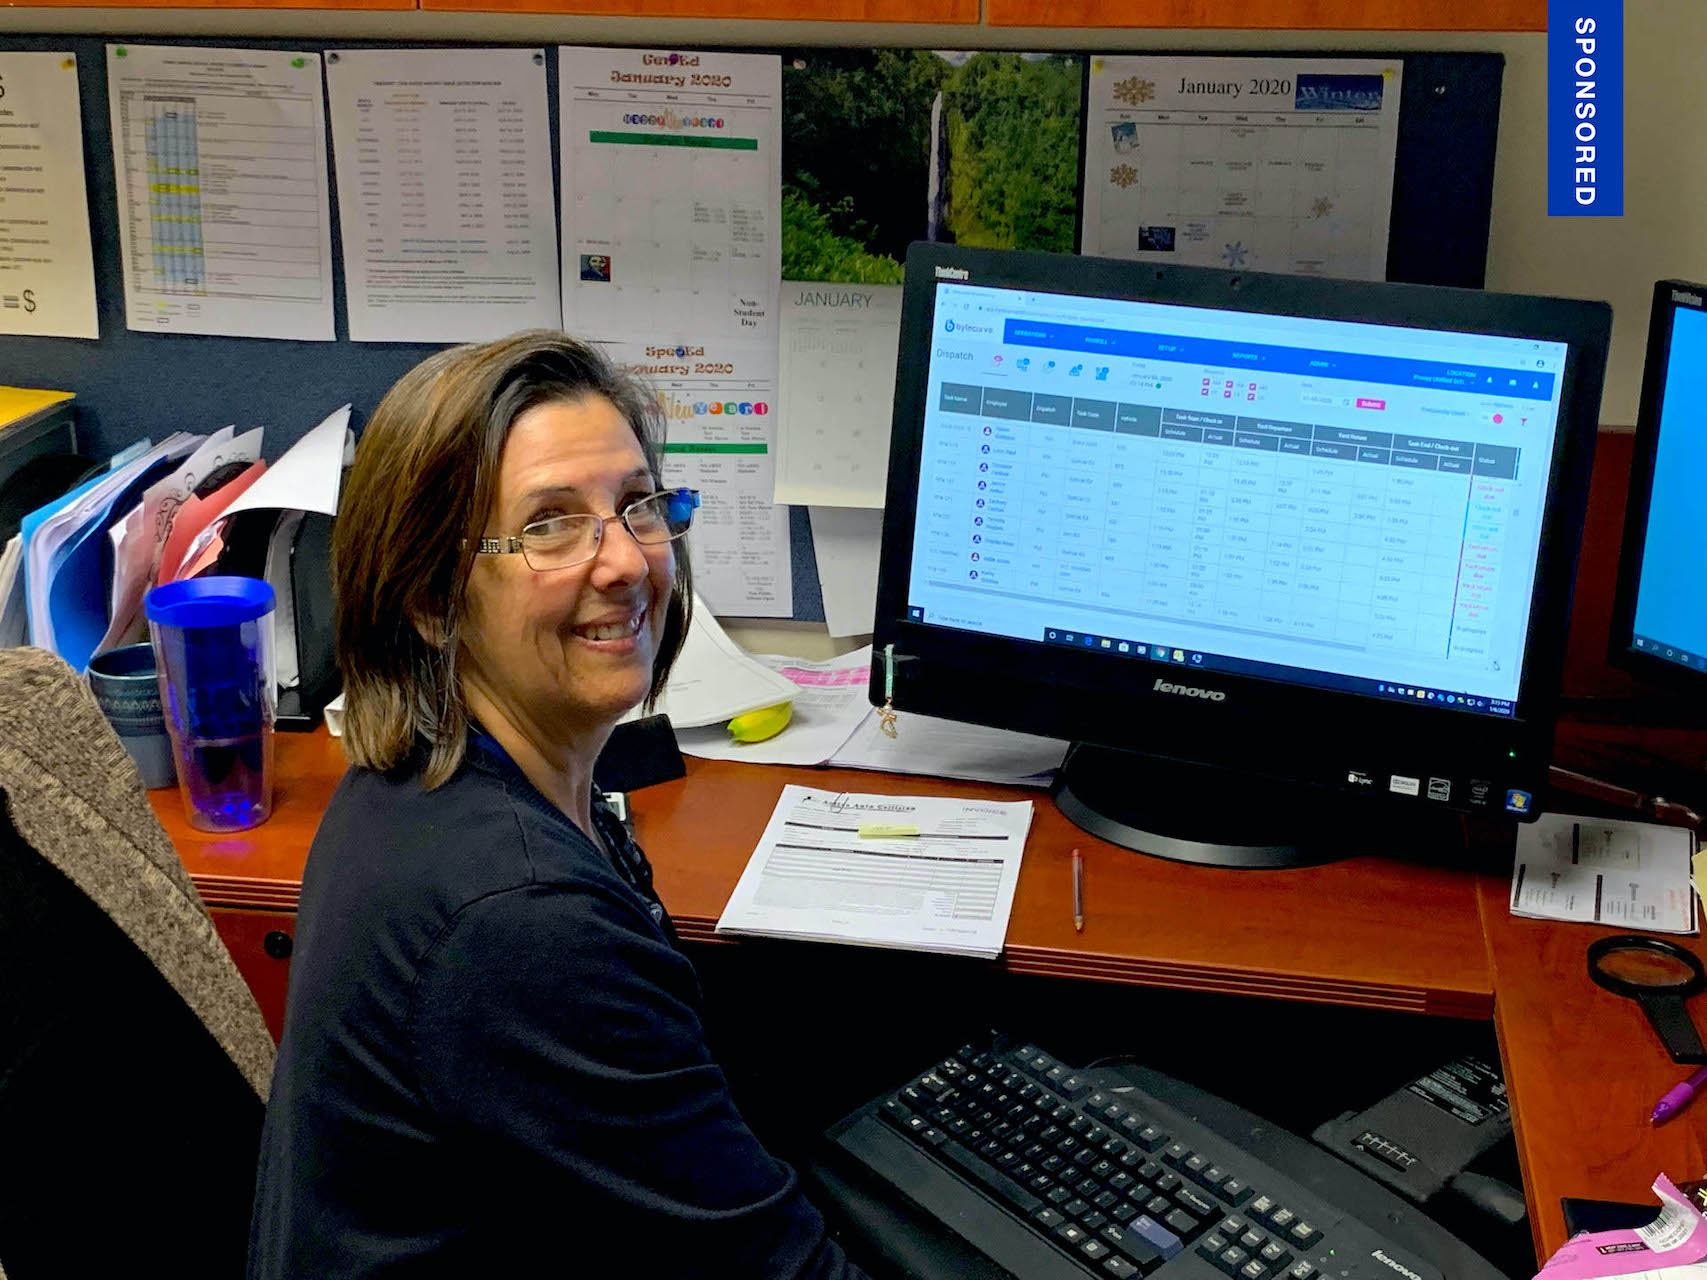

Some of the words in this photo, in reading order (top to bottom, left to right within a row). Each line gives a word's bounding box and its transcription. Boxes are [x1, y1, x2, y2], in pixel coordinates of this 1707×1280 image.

[610, 70, 685, 87] January
[690, 74, 732, 88] 2020
[1177, 77, 1242, 99] January
[1244, 78, 1292, 96] 2020
[1298, 85, 1382, 103] Winter
[23, 289, 37, 313] $
[794, 291, 873, 308] JANUARY
[733, 308, 765, 318] Student
[741, 318, 757, 330] Day
[936, 347, 974, 362] Dispatch
[695, 362, 734, 375] 2020
[1152, 678, 1227, 702] lenovo
[1371, 1249, 1423, 1280] lenovo
